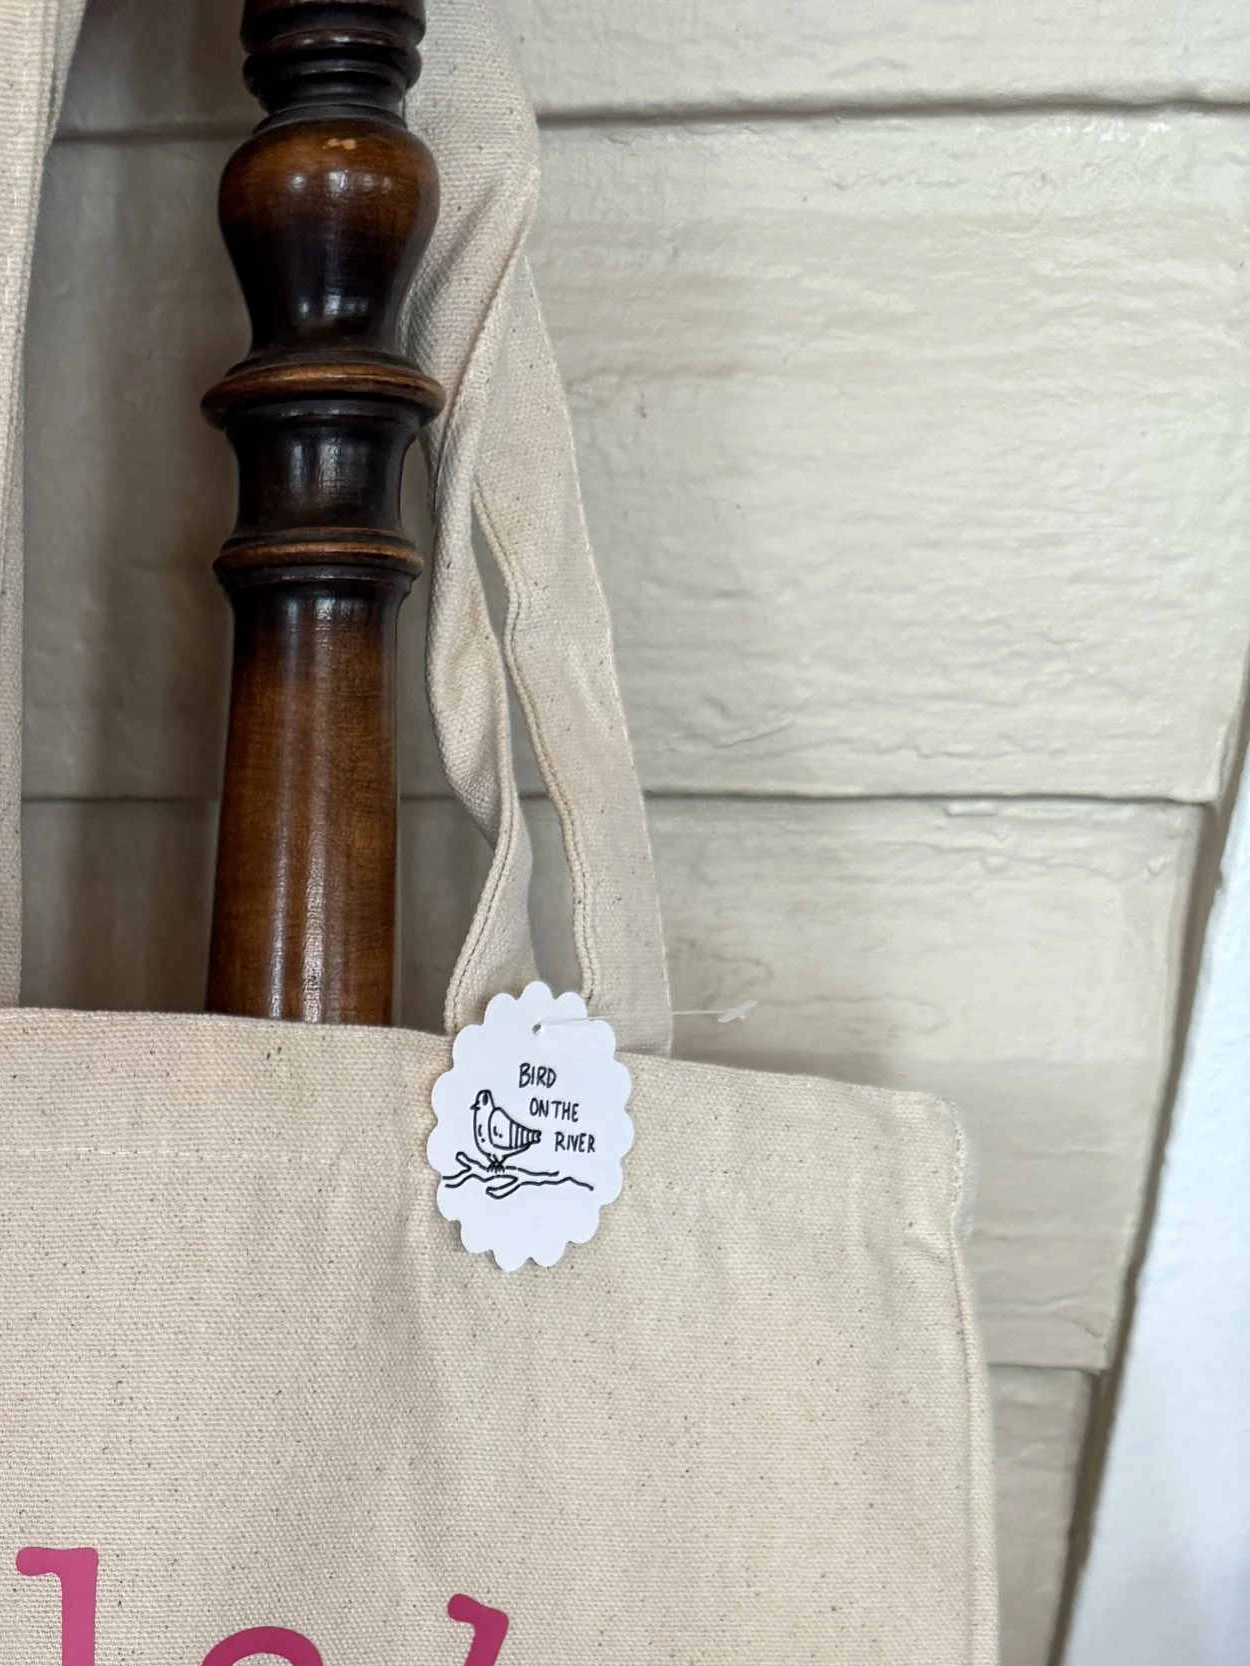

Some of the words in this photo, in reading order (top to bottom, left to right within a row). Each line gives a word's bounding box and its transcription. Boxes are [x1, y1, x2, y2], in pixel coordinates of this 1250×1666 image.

[518, 1062, 557, 1088] BIRD
[529, 1097, 549, 1118] ON
[550, 1100, 580, 1123] THE
[554, 1131, 596, 1153] RIVER
